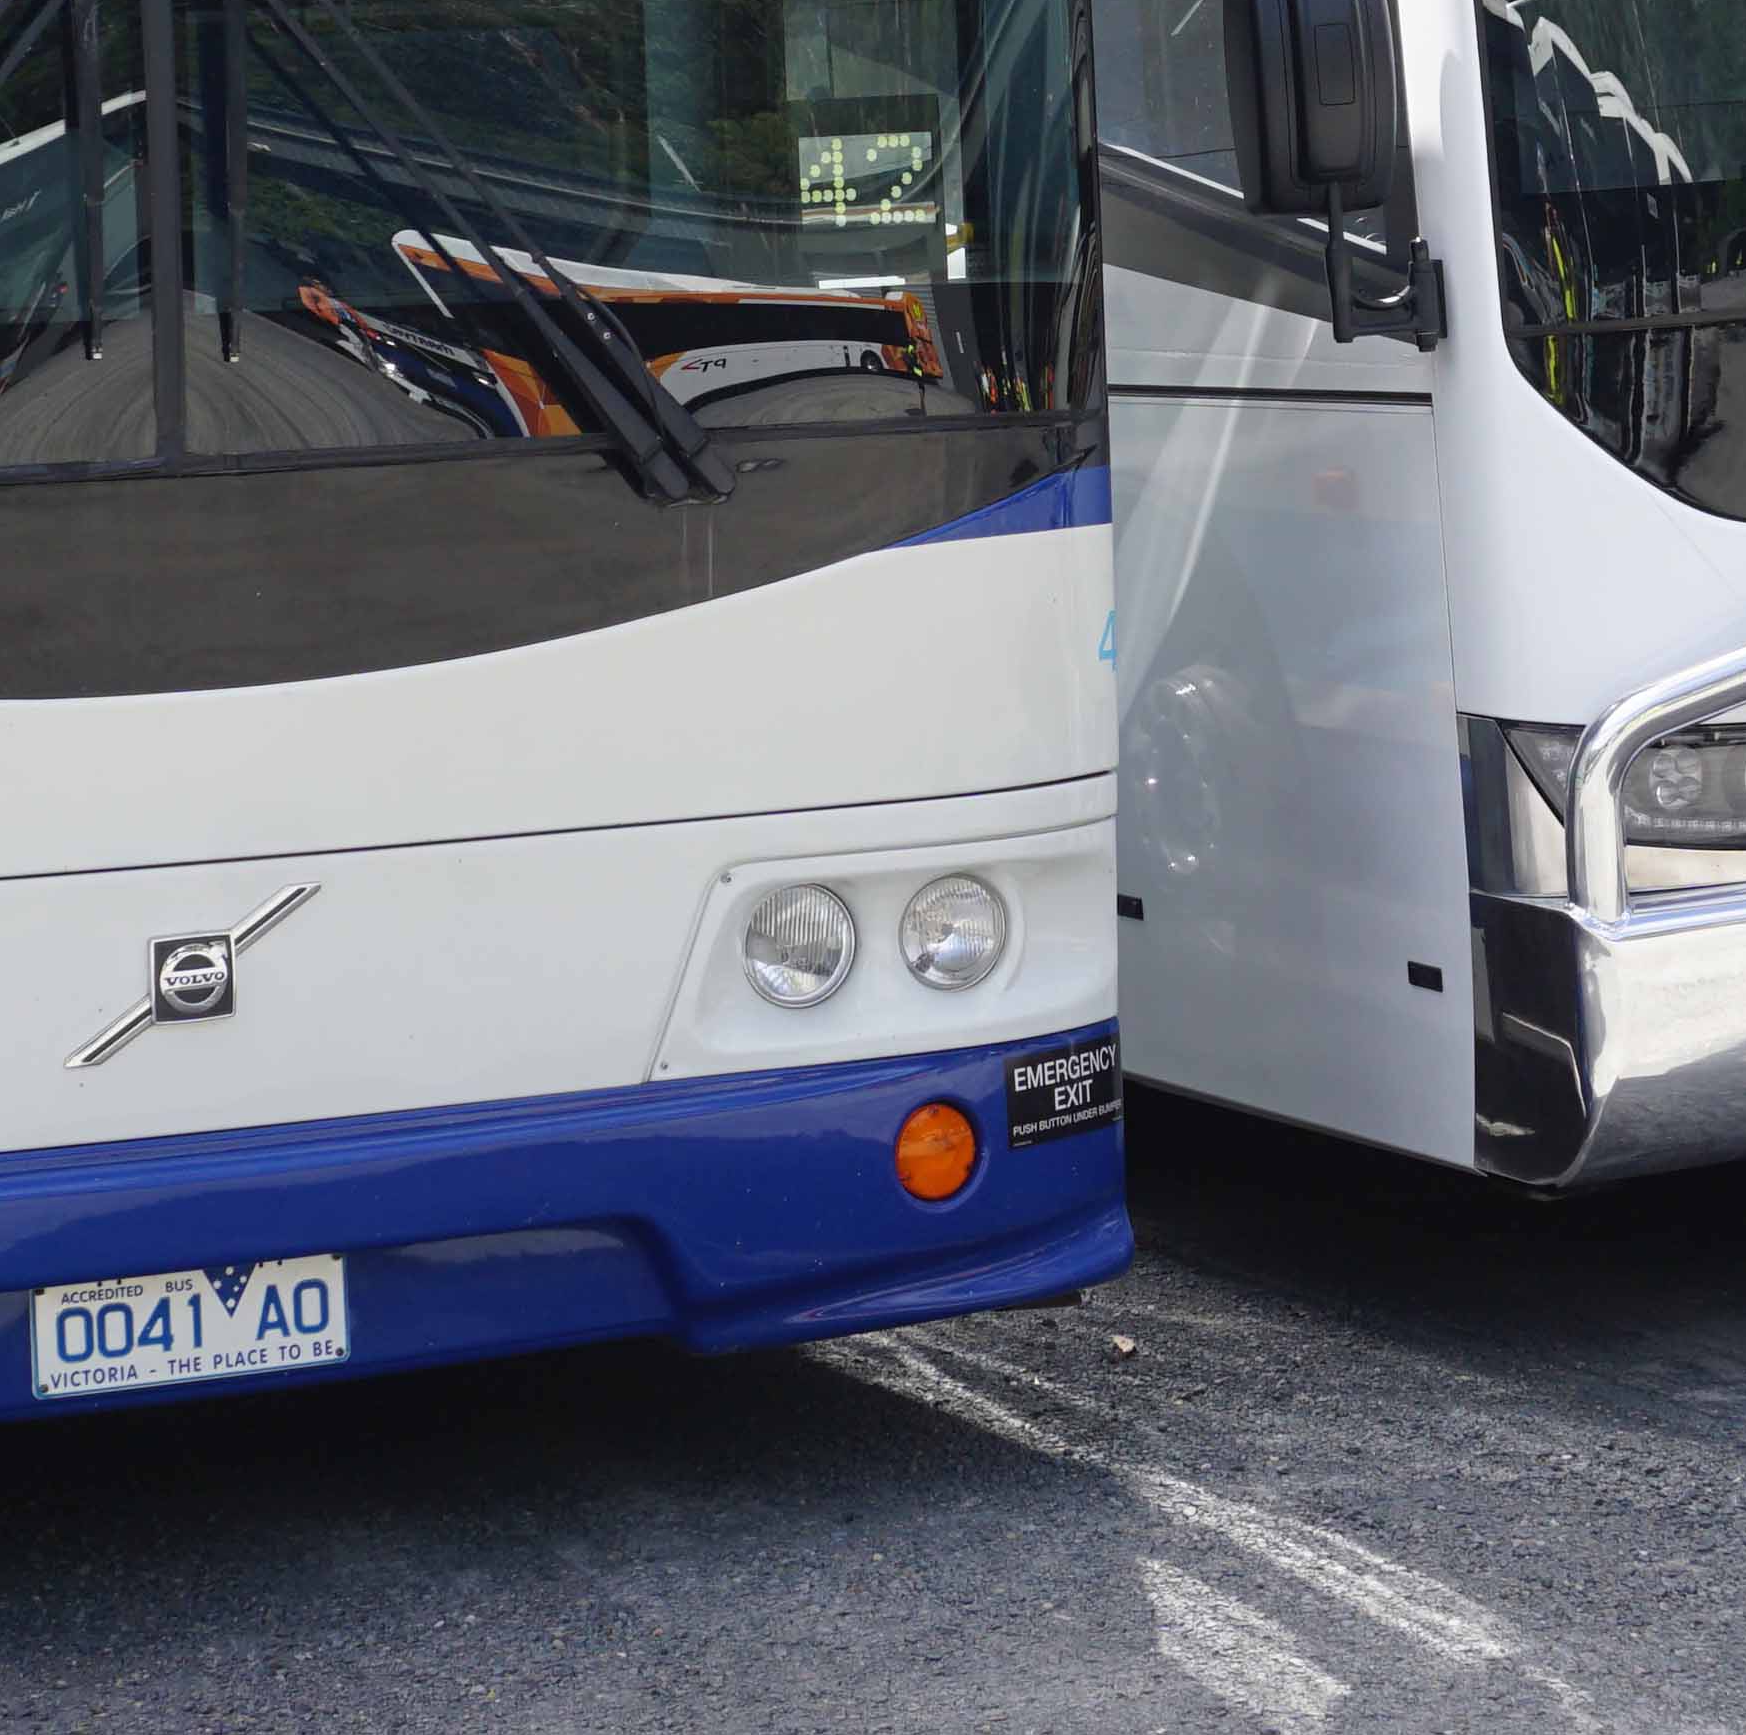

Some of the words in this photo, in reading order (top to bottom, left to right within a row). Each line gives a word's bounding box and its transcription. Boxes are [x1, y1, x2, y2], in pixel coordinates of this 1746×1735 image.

[164, 971, 225, 986] VOLVO
[1014, 1044, 1116, 1092] EMERGENCY
[1054, 1079, 1093, 1111] EXIT
[1013, 1123, 1037, 1137] PUSH
[1039, 1113, 1072, 1131] BUTTON
[1073, 1107, 1097, 1122] UNDER
[61, 1285, 143, 1305] ACCREDITED
[165, 1279, 193, 1293] BUS
[56, 1293, 203, 1363] 0041
[255, 1278, 329, 1341] AO
[50, 1365, 138, 1389] VICTORIA
[167, 1357, 202, 1375] THE
[213, 1349, 268, 1369] PLACE
[278, 1345, 302, 1361] TO
[312, 1340, 334, 1357] BE
